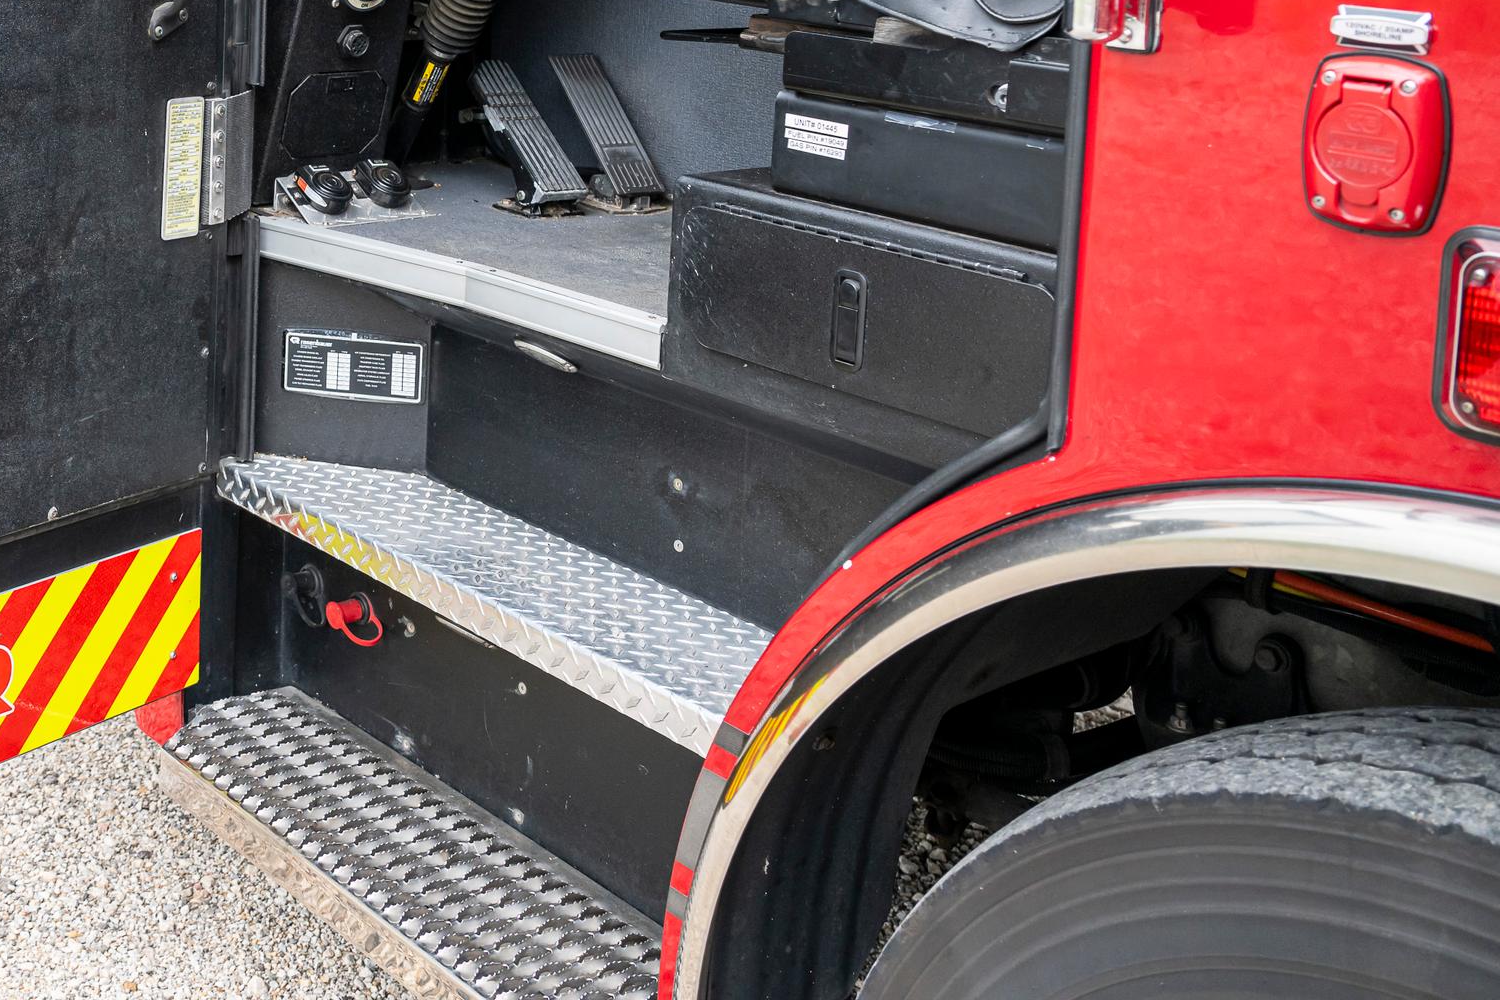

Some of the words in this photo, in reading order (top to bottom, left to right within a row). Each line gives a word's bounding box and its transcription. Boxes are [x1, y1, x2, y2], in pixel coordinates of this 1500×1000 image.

[1354, 29, 1402, 41] SHORELINE
[794, 118, 815, 127] UNIT#
[817, 122, 837, 132] 01445
[788, 130, 804, 138] FUEL
[790, 140, 803, 148] GAS
